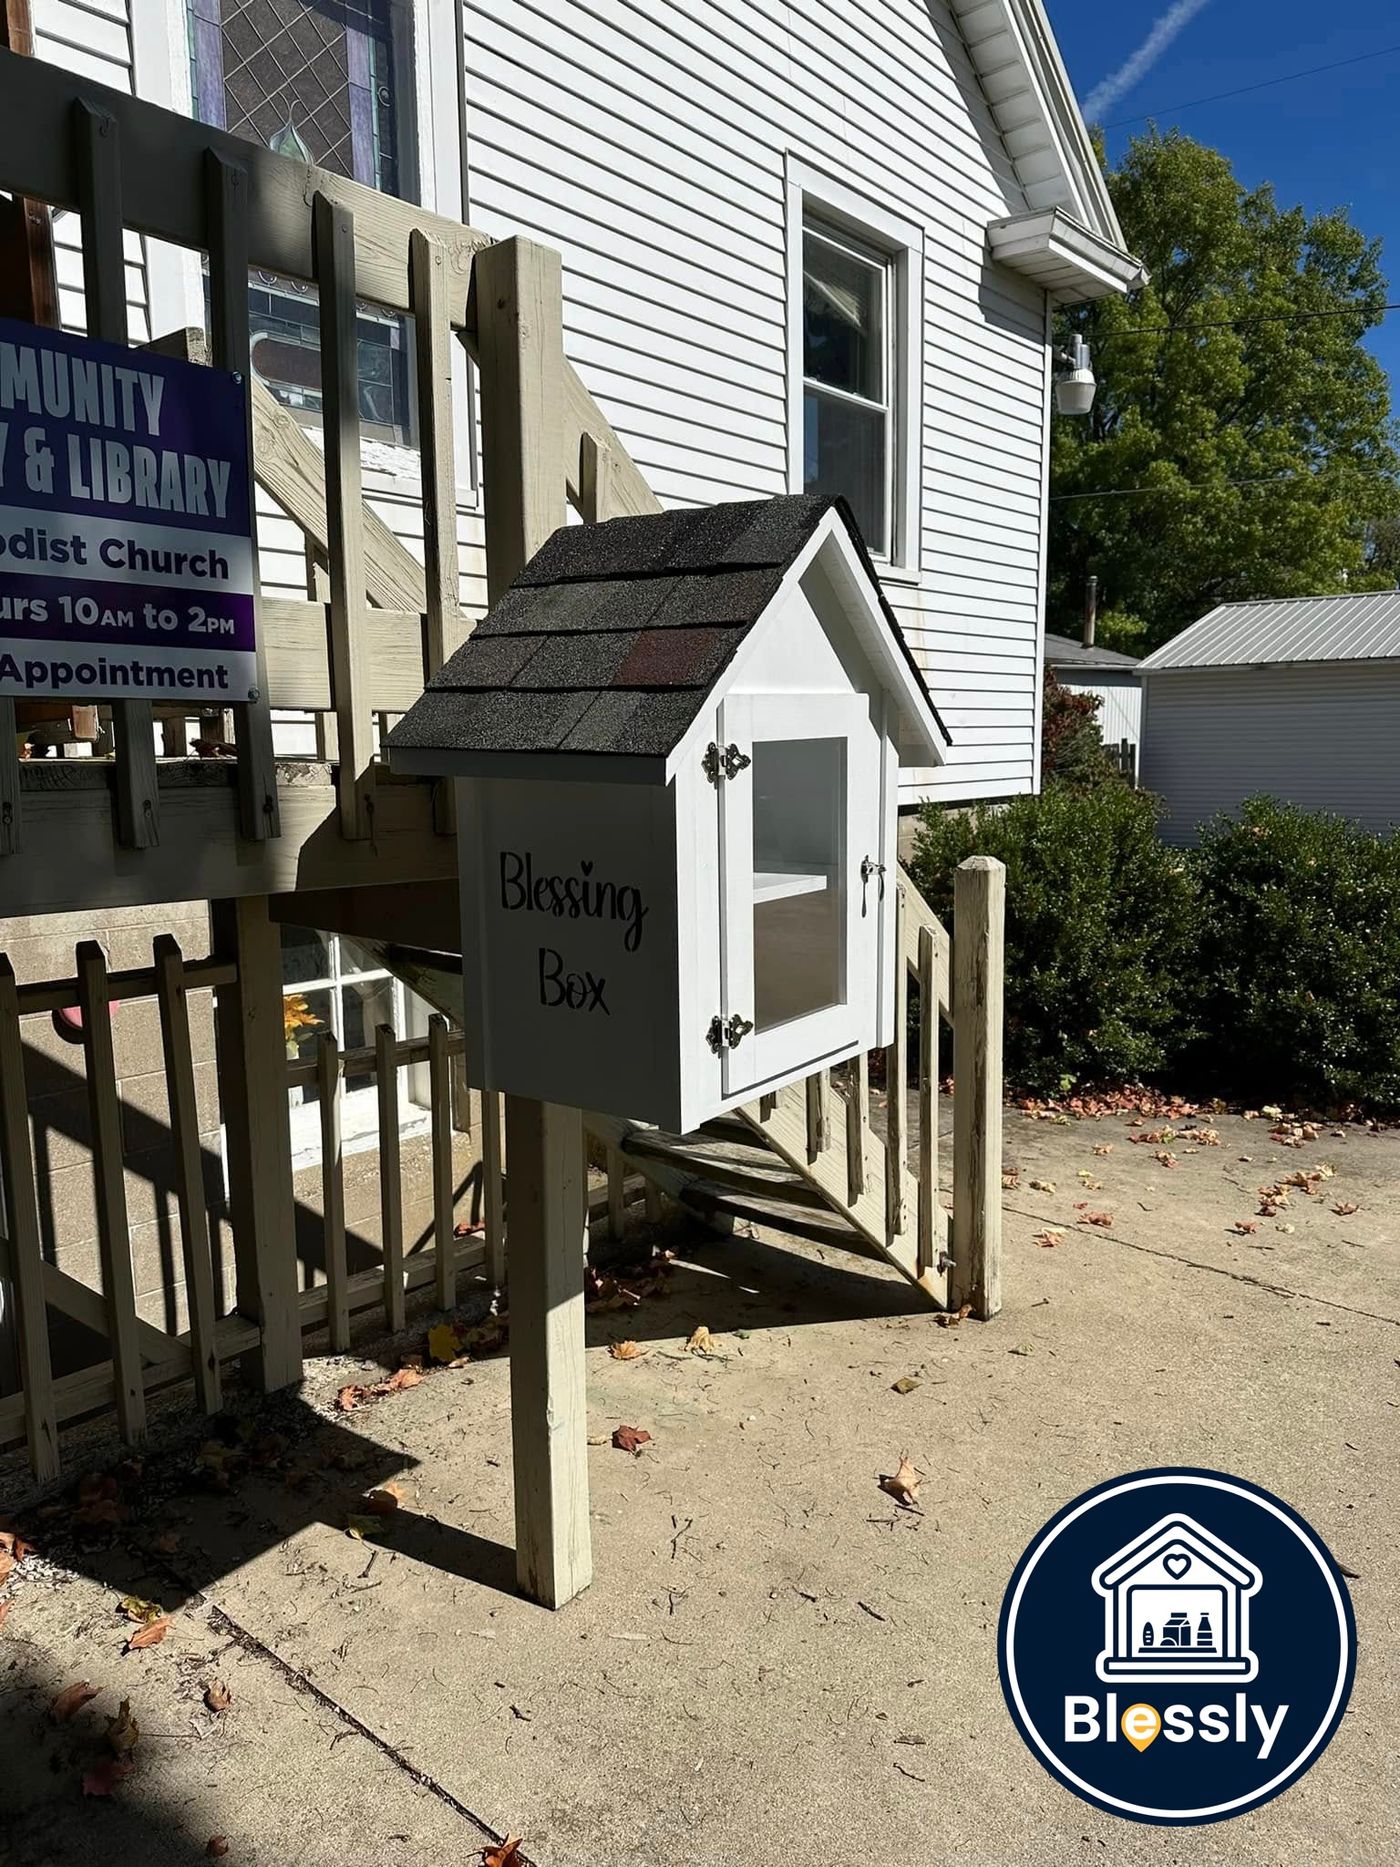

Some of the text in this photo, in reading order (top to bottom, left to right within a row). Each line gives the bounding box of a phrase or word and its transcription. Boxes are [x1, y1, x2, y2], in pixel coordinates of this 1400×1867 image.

[0, 341, 164, 436] MUNITY
[24, 427, 54, 494] &
[67, 434, 230, 518] LIBRARY
[100, 537, 229, 580] Church
[58, 595, 134, 628] 10AM
[143, 604, 178, 630] to
[187, 606, 235, 635] 2PM
[0, 653, 229, 690] Appointment
[500, 851, 649, 952] Blessing
[538, 947, 610, 1015] Box
